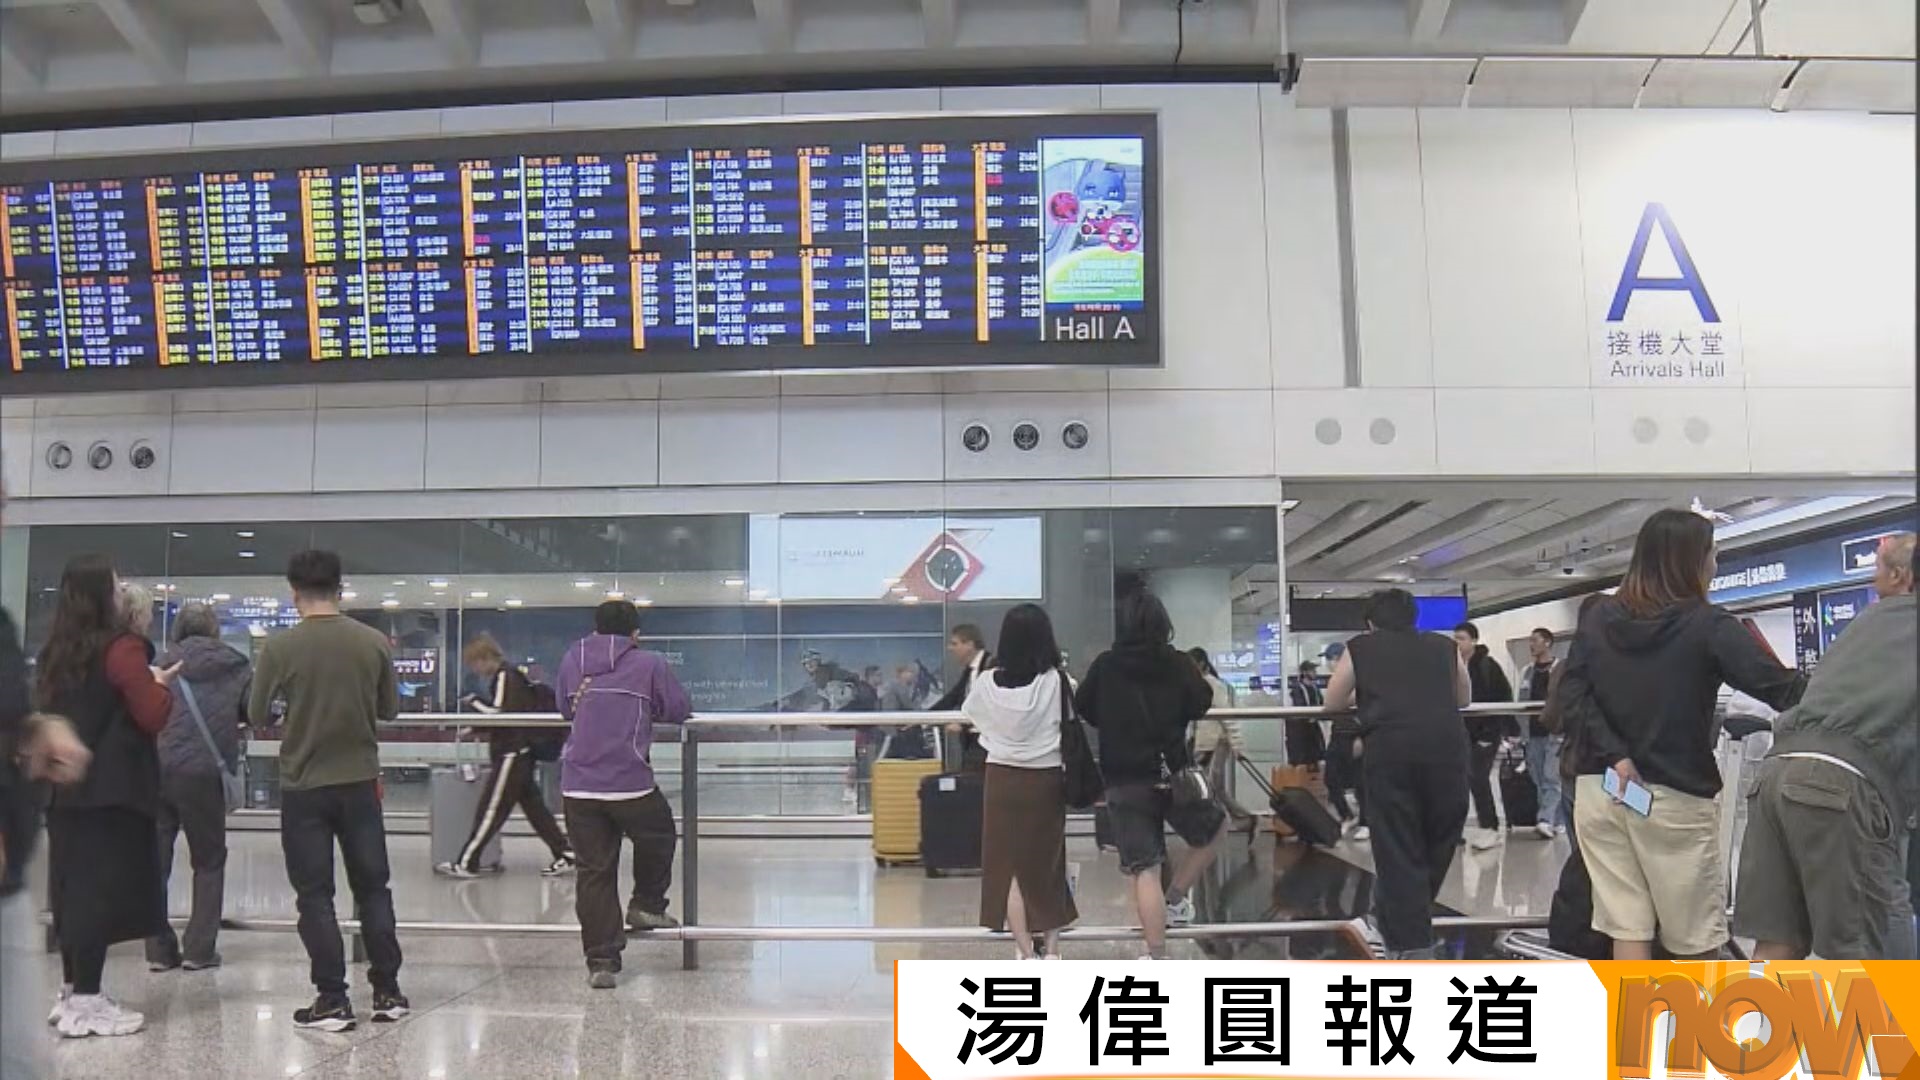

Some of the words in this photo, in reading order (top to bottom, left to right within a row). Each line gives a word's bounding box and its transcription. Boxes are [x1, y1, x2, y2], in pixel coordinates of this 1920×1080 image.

[1605, 201, 1722, 323] A
[1056, 316, 1104, 340] Hall
[1113, 316, 1136, 340] A
[1607, 329, 1725, 355] 接機大堂
[1611, 360, 1682, 377] Arrivals
[1690, 360, 1724, 377] Hall
